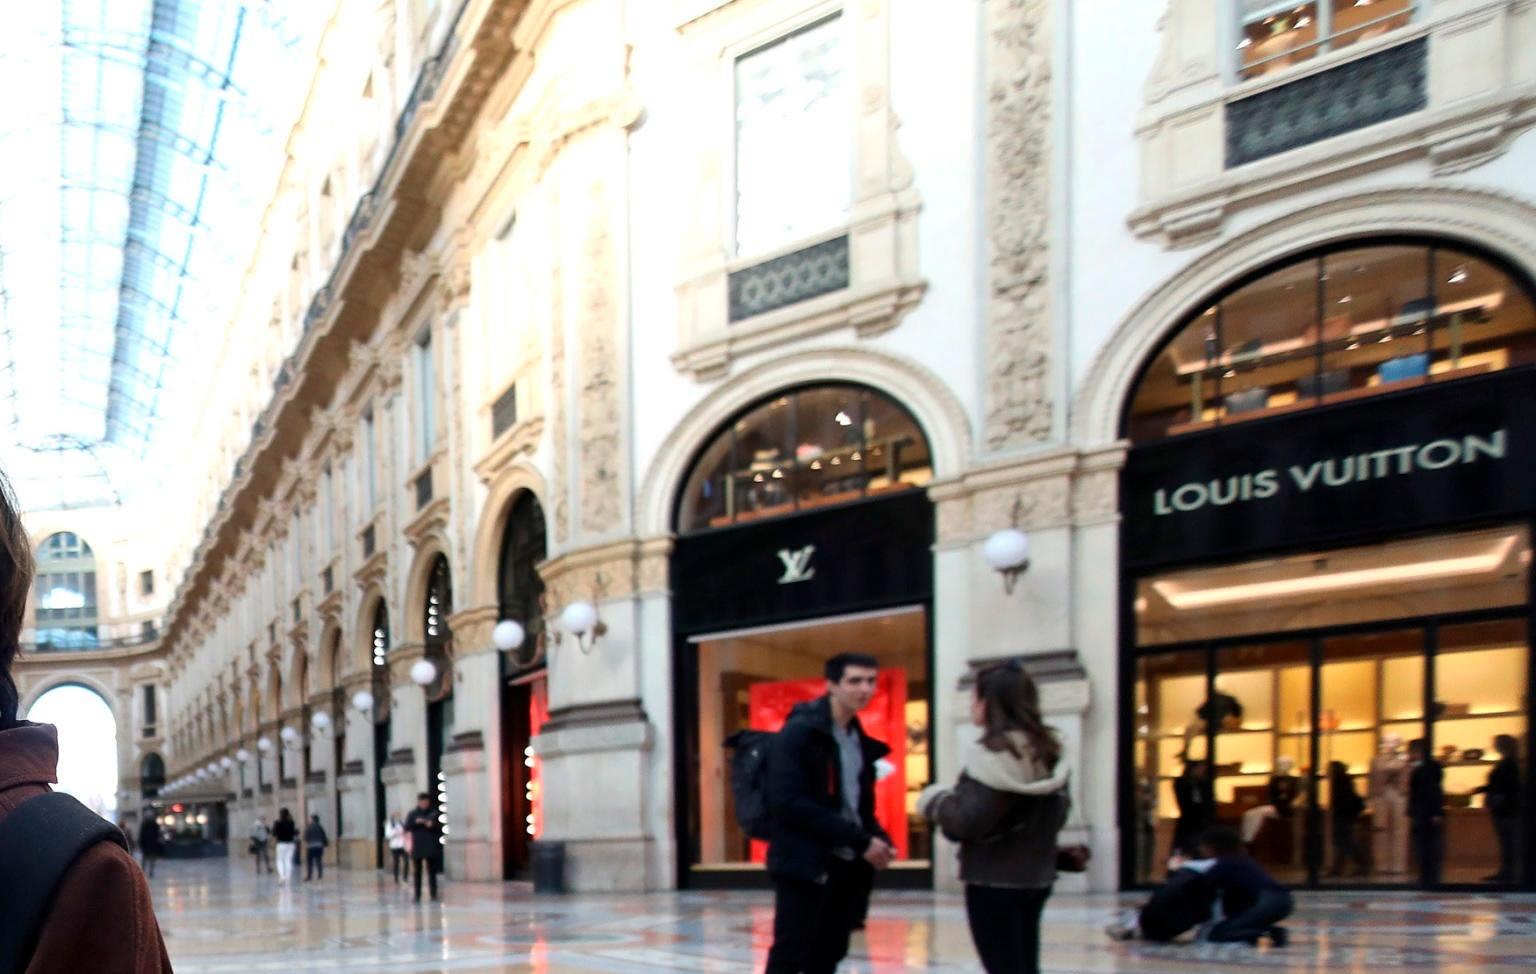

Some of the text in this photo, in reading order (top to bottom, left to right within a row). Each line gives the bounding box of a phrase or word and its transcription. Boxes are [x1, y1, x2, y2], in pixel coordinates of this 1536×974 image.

[1153, 430, 1506, 516] LOUIS VUITTON
[776, 544, 816, 585] LV
